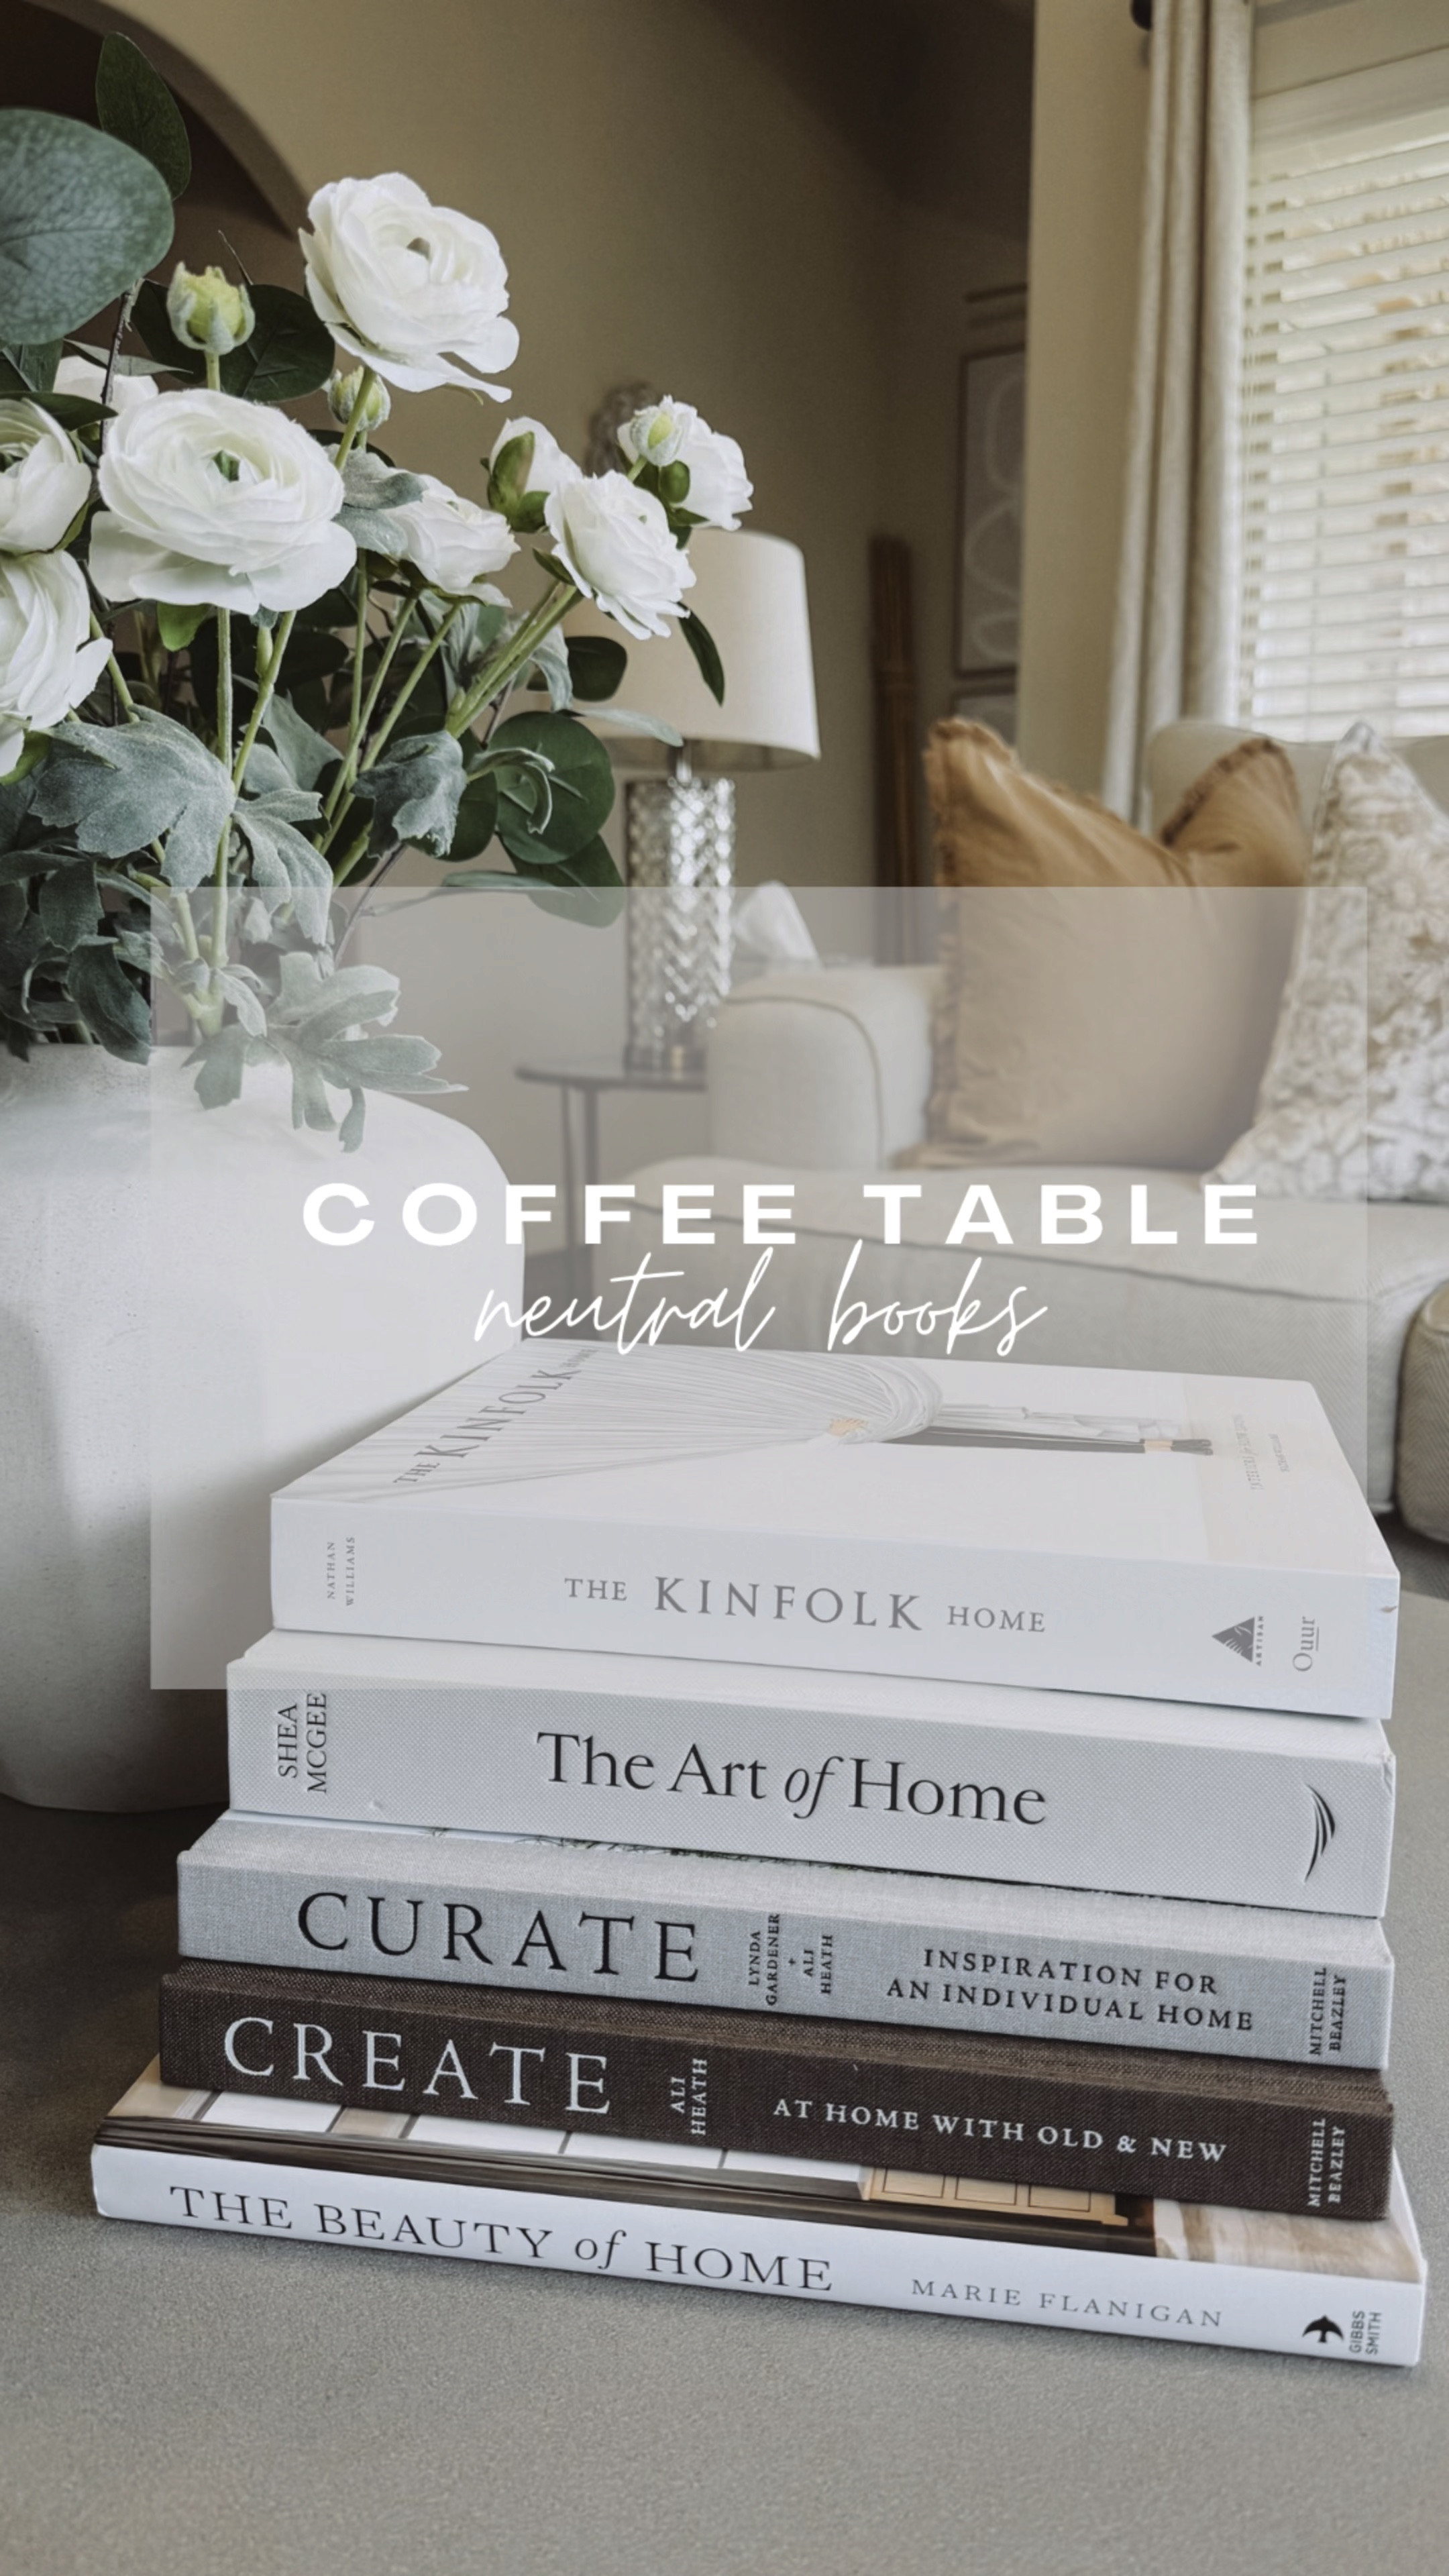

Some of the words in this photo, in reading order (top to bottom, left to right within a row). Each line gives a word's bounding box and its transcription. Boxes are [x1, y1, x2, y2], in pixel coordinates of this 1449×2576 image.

[413, 1369, 582, 1458] KINFOLK
[392, 1462, 440, 1483] THE
[327, 1542, 335, 1599] NATHAN
[345, 1536, 355, 1606] WILLIAMS
[564, 1577, 627, 1601] THE
[655, 1576, 922, 1631] KINFOLK
[947, 1605, 1045, 1633] HOME
[1256, 1615, 1265, 1667] ARTISAN
[1292, 1615, 1316, 1672] Ouur
[278, 1702, 298, 1779] SHEA
[306, 1693, 327, 1794] MCGEE
[537, 1732, 655, 1790] The
[666, 1743, 767, 1800] Art
[784, 1756, 844, 1819] of
[848, 1757, 1047, 1825] Home
[297, 1892, 698, 1983] CURATE
[748, 1930, 761, 1986] LYNDA
[765, 1913, 781, 2006] GARDENER
[803, 1948, 814, 1977] ALI
[820, 1934, 833, 1995] HEATH
[923, 1949, 1142, 1988] INSPIRATION
[1155, 1971, 1218, 1994] FOR
[886, 1978, 929, 2000] AN
[943, 1984, 1143, 2020] INDIVIDUAL
[1157, 2004, 1253, 2031] HOME
[1309, 1967, 1327, 2056] MITCHELL
[1329, 1974, 1346, 2051] BEAZLEY
[223, 2017, 611, 2115] CREATE
[671, 2076, 686, 2114] ALI
[691, 2057, 708, 2135] HEATH
[773, 2098, 813, 2118] AT
[825, 2102, 919, 2131] HOME
[932, 2114, 1024, 2141] WITH
[1037, 2126, 1104, 2149] OLD
[1116, 2135, 1136, 2153] &
[1150, 2137, 1226, 2162] NEW
[1307, 2118, 1326, 2208] MITCHELL
[1328, 2125, 1346, 2204] BEAZLEY
[169, 2186, 292, 2230] THE
[313, 2203, 553, 2259] BEAUTY
[575, 2229, 627, 2270] of
[645, 2241, 833, 2292] HOME
[911, 2279, 1022, 2306] MARIE
[1038, 2292, 1222, 2328] FLANIGAN
[1348, 2310, 1366, 2353] GIBBS
[1364, 2311, 1382, 2355] SMITH
